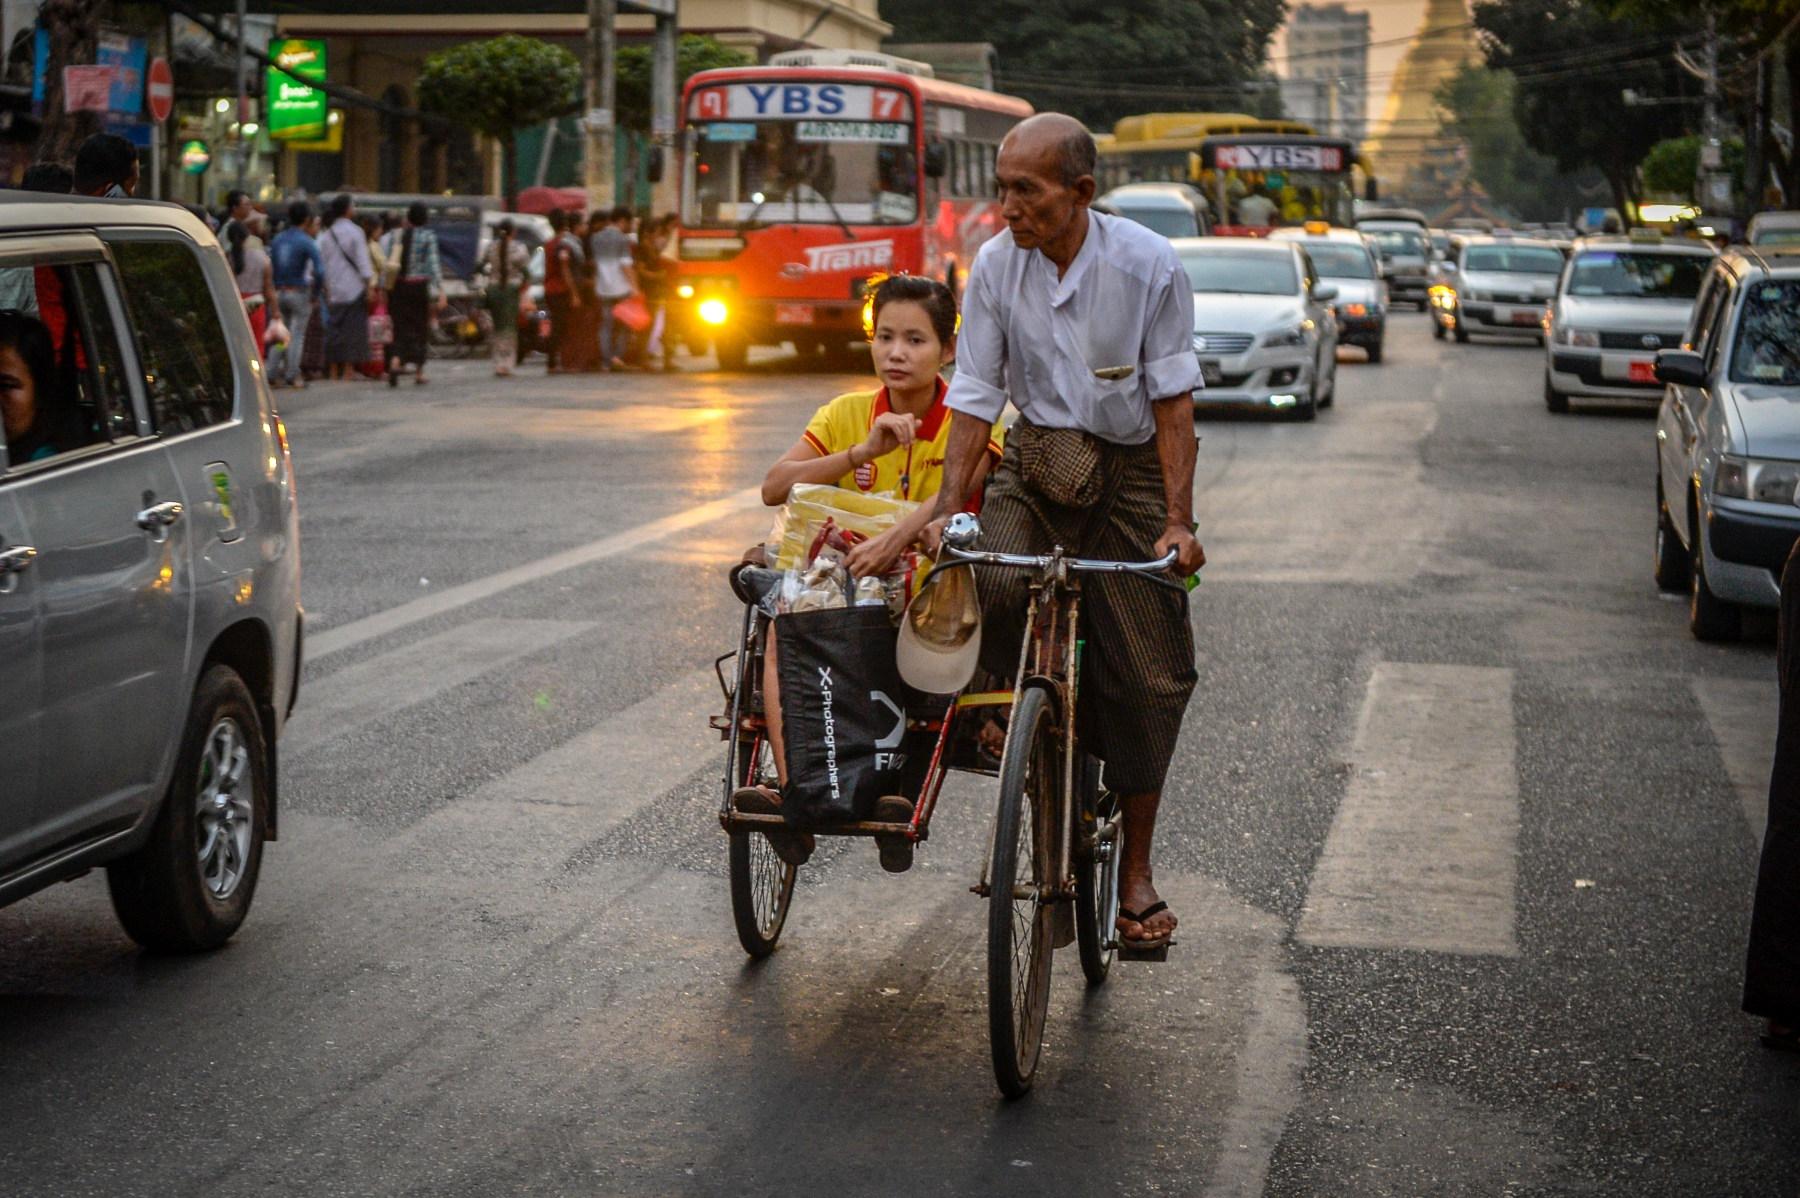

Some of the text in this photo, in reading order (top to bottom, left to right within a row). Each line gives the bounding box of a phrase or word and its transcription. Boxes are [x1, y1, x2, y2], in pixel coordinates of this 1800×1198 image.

[747, 85, 845, 115] YBS
[877, 91, 898, 117] 7
[1243, 146, 1316, 169] YBS
[818, 666, 840, 800] X-Photographers
